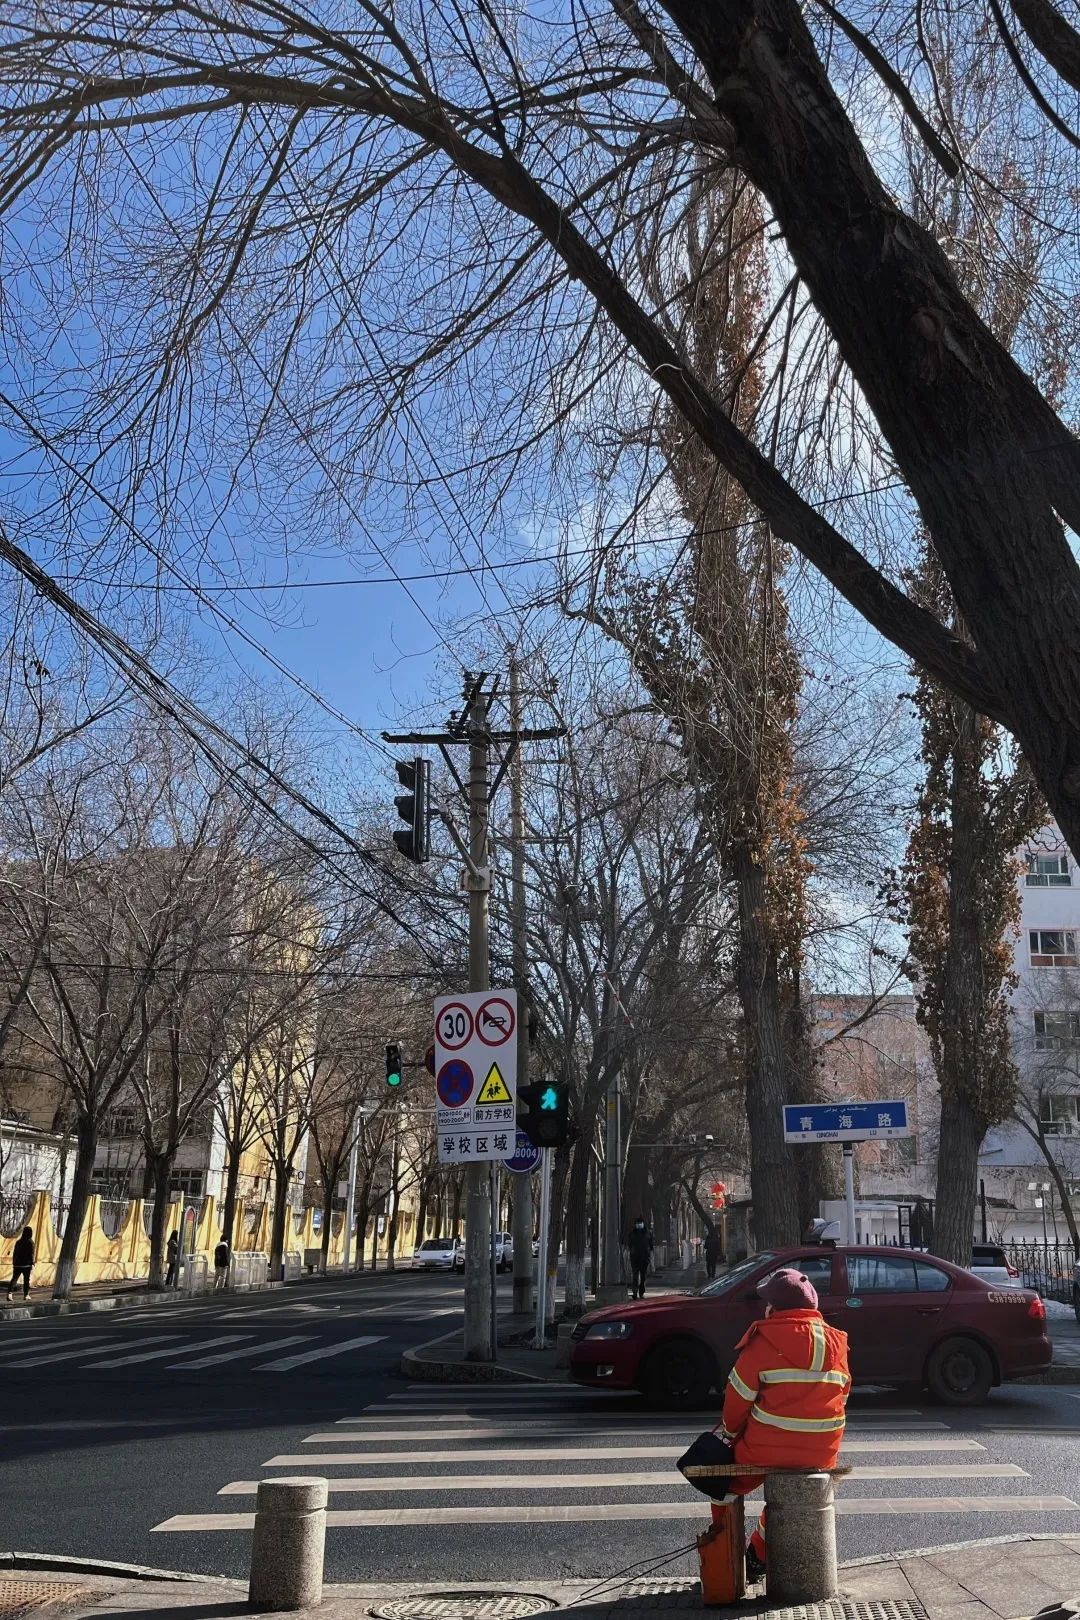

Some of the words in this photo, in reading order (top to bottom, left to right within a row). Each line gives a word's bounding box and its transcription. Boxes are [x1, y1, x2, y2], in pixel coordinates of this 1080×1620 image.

[444, 1013, 465, 1039] 30
[475, 1108, 512, 1120] 前方学校
[800, 1113, 892, 1130] 青海路
[443, 1134, 508, 1154] 学校区域
